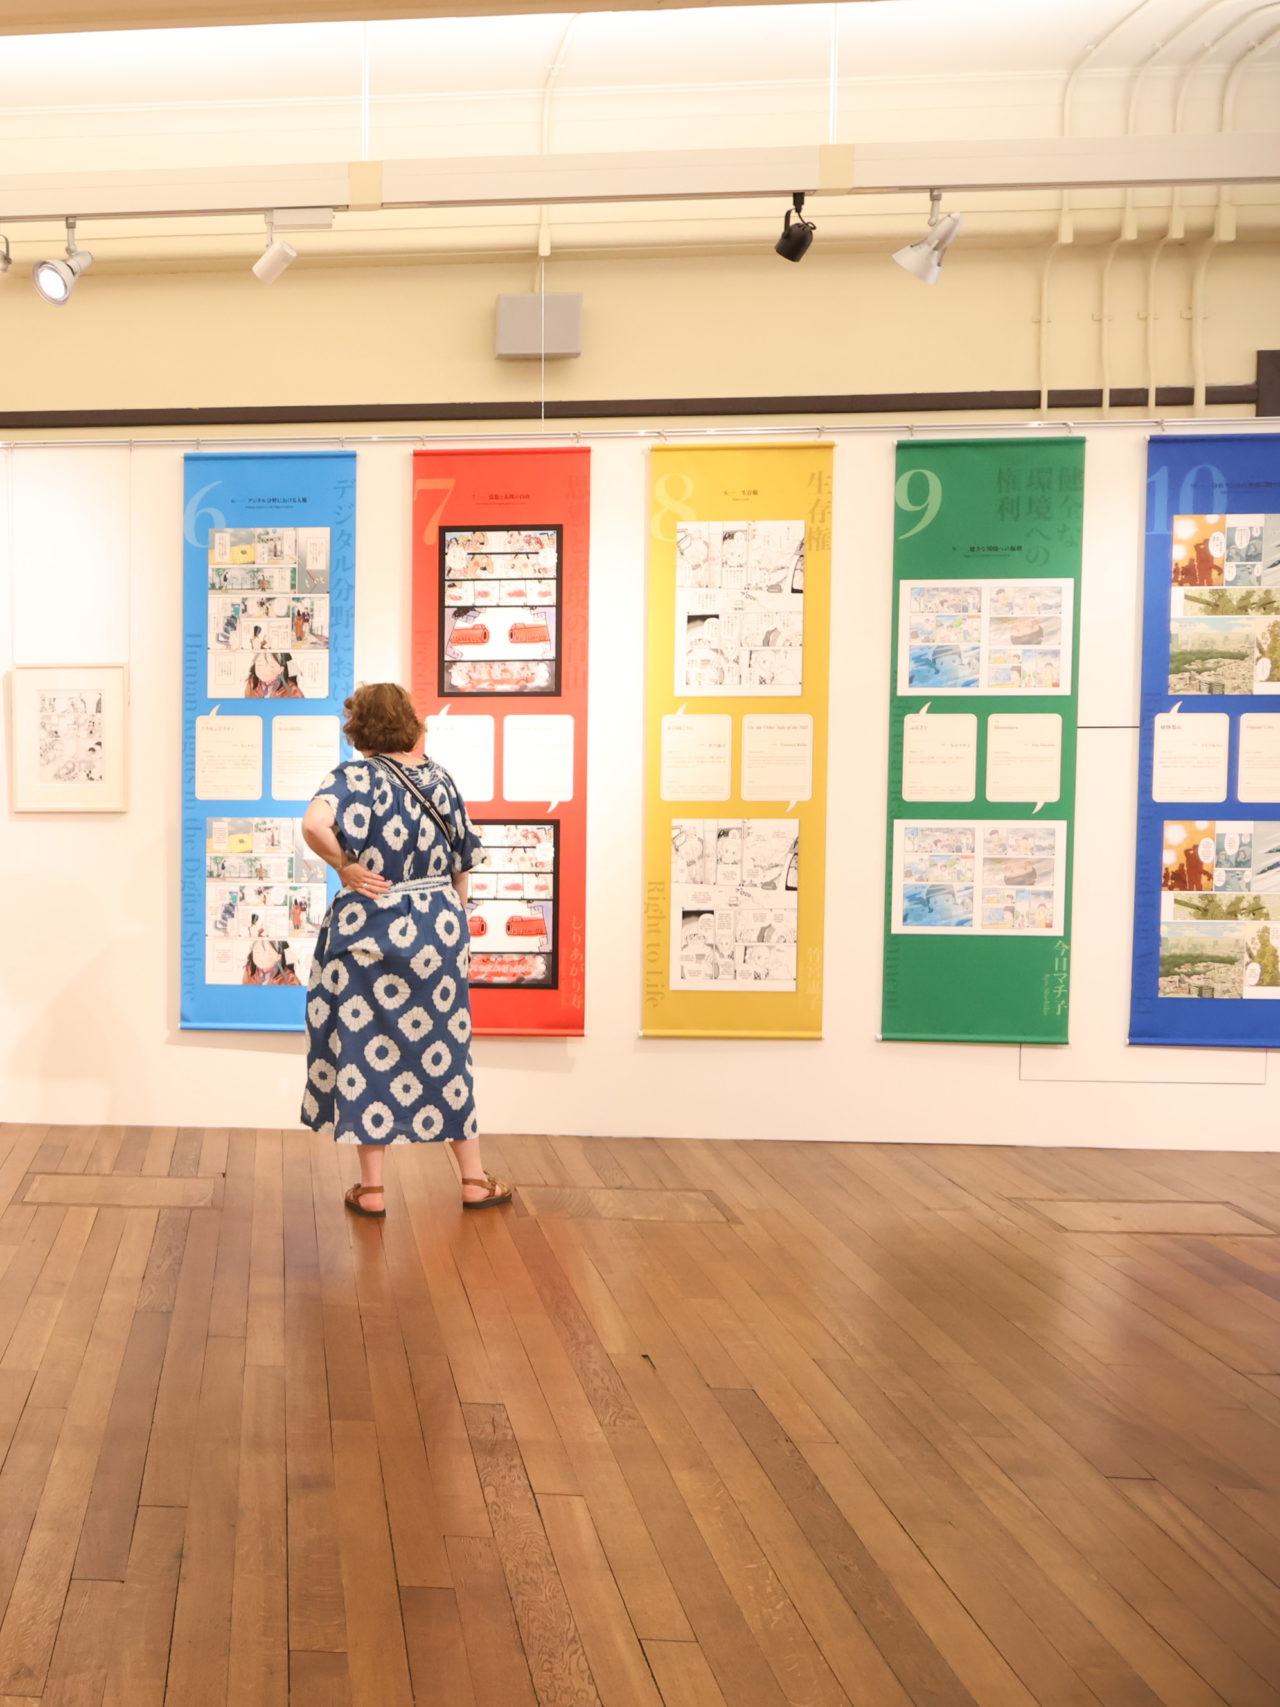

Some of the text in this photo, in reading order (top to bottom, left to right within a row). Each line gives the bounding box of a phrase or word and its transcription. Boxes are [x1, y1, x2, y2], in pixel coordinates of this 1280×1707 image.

[184, 480, 226, 549] 6
[413, 478, 456, 546] 7
[651, 472, 696, 542] 8
[808, 470, 832, 552] 生存権
[895, 469, 942, 540] 9
[1146, 464, 1228, 536] 10
[645, 880, 666, 1009] Right to Life
[1053, 938, 1070, 1017] 今日マチ子
